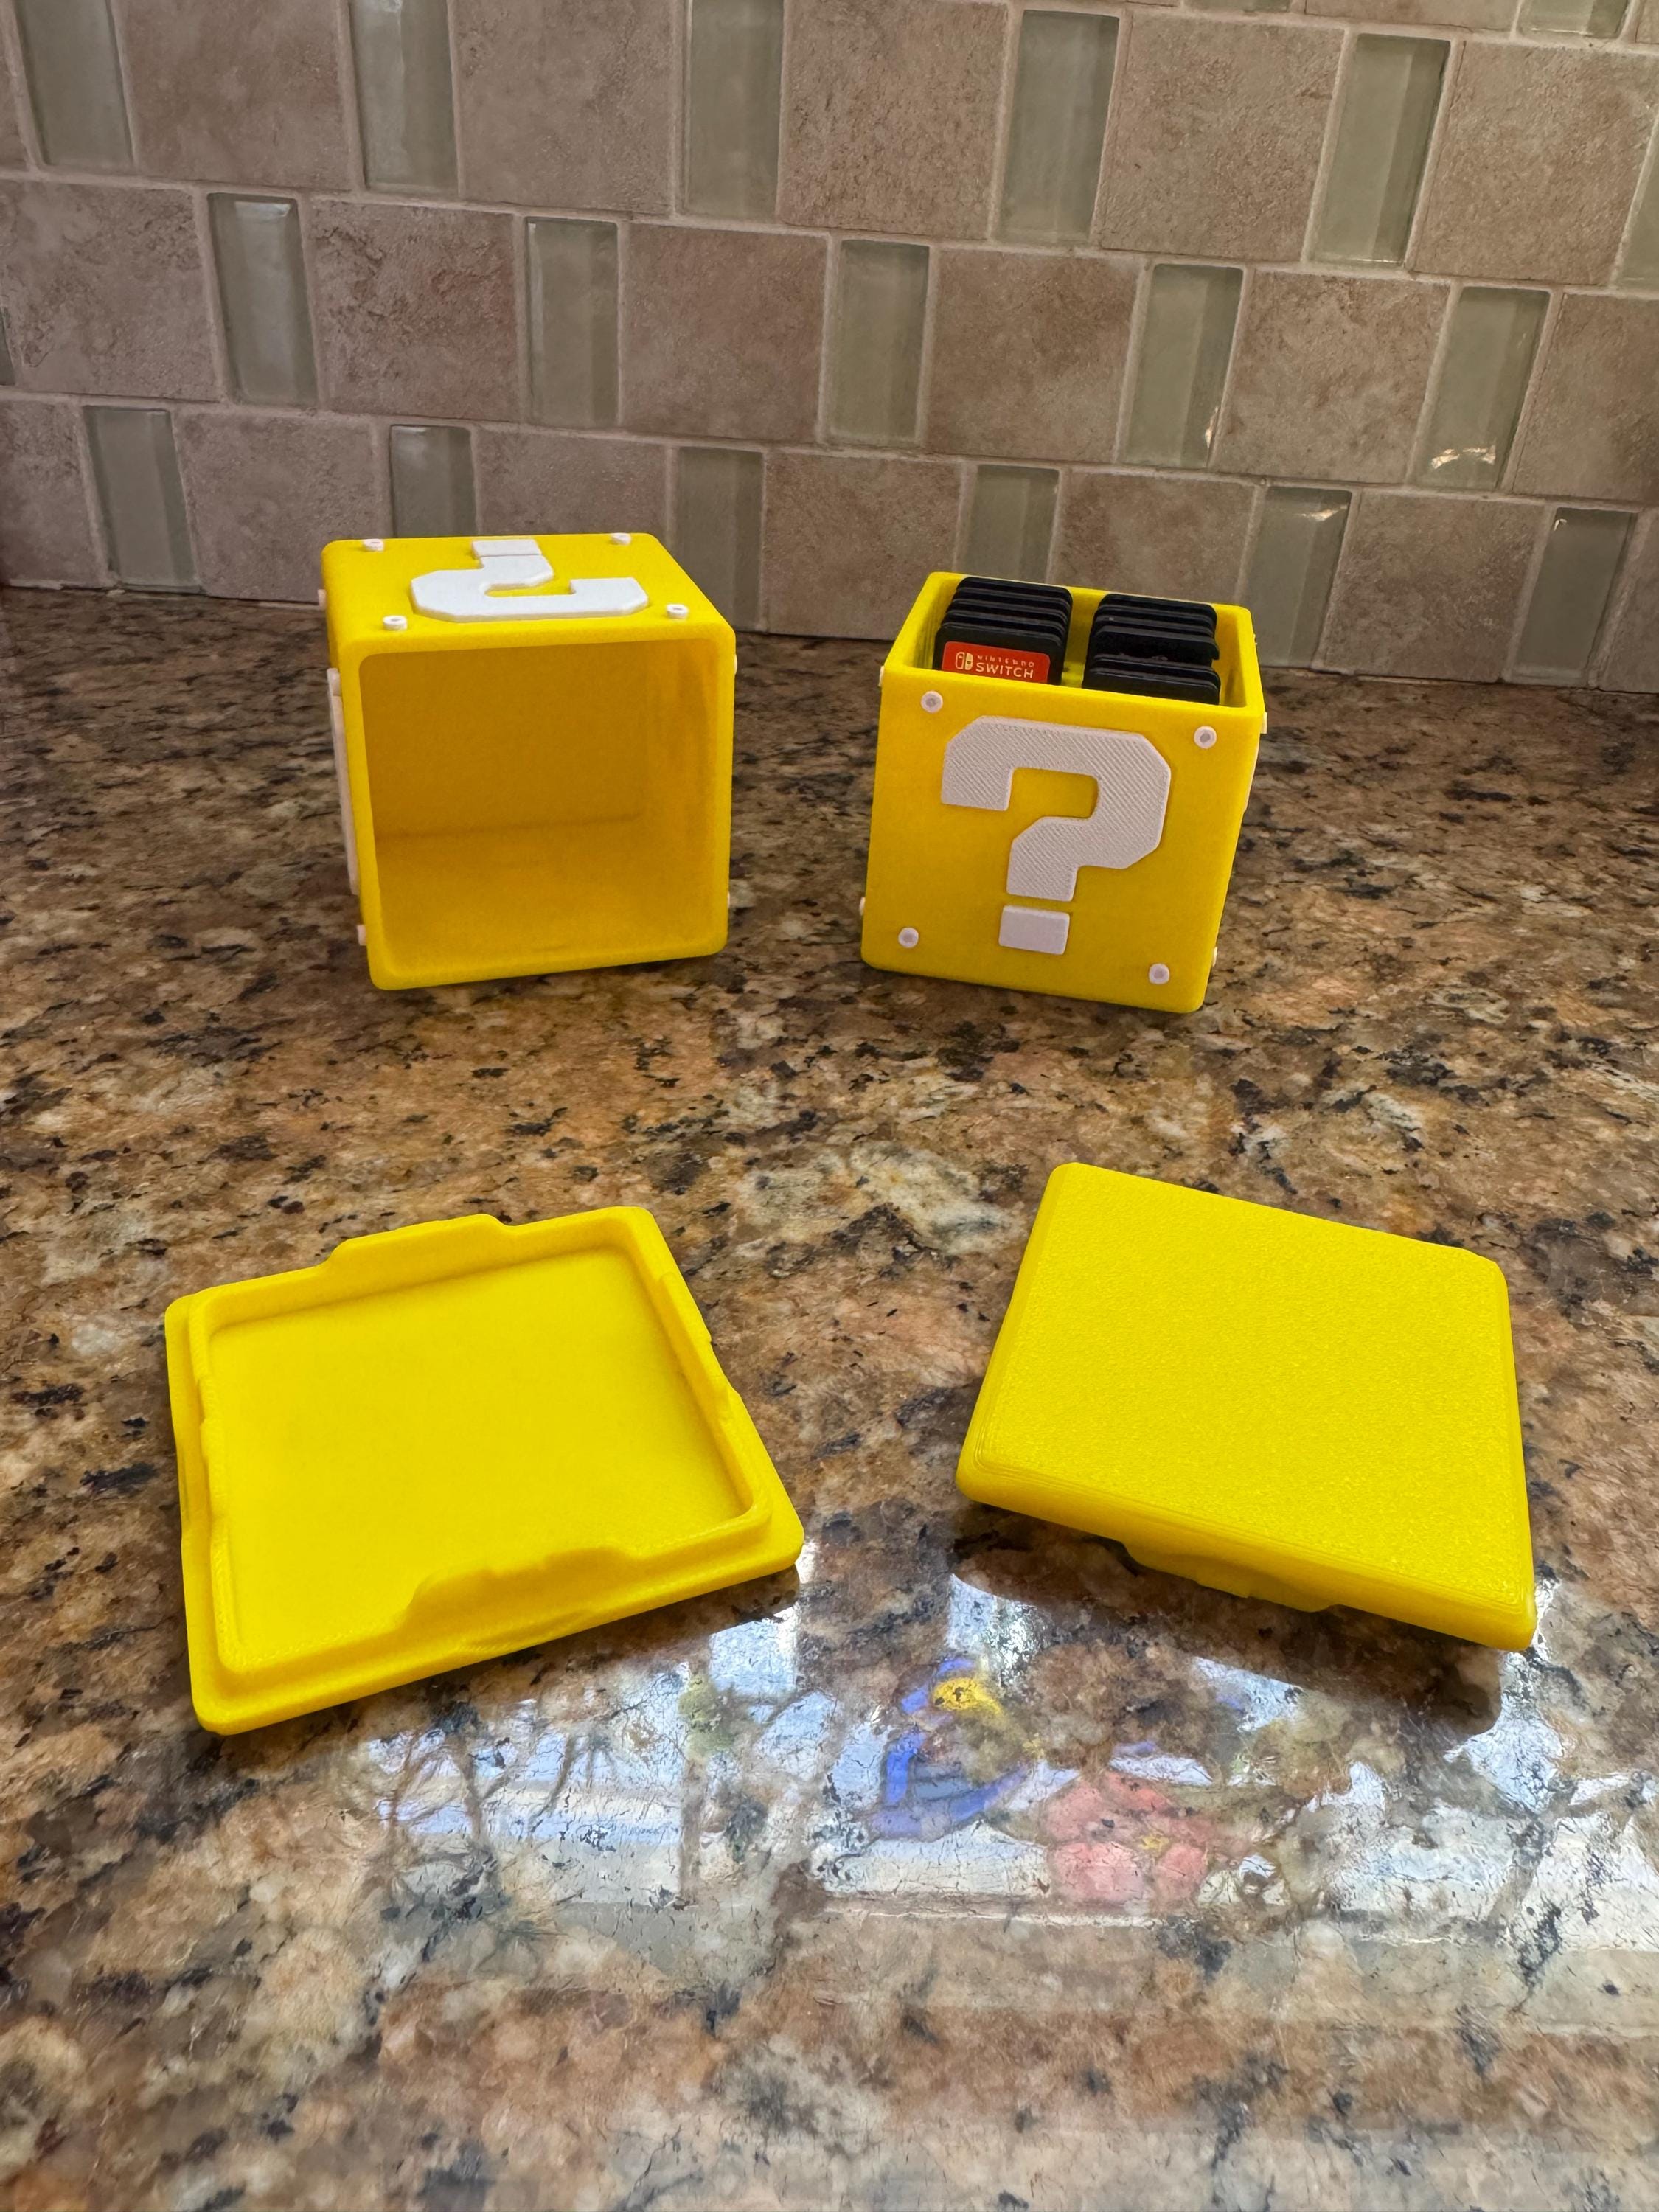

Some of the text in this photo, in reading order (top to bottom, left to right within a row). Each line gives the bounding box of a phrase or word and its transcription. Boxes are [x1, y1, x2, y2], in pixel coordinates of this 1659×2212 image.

[977, 655, 1035, 668] NINTENDO
[975, 662, 1034, 678] SWITCH
[940, 714, 1172, 955] ?
